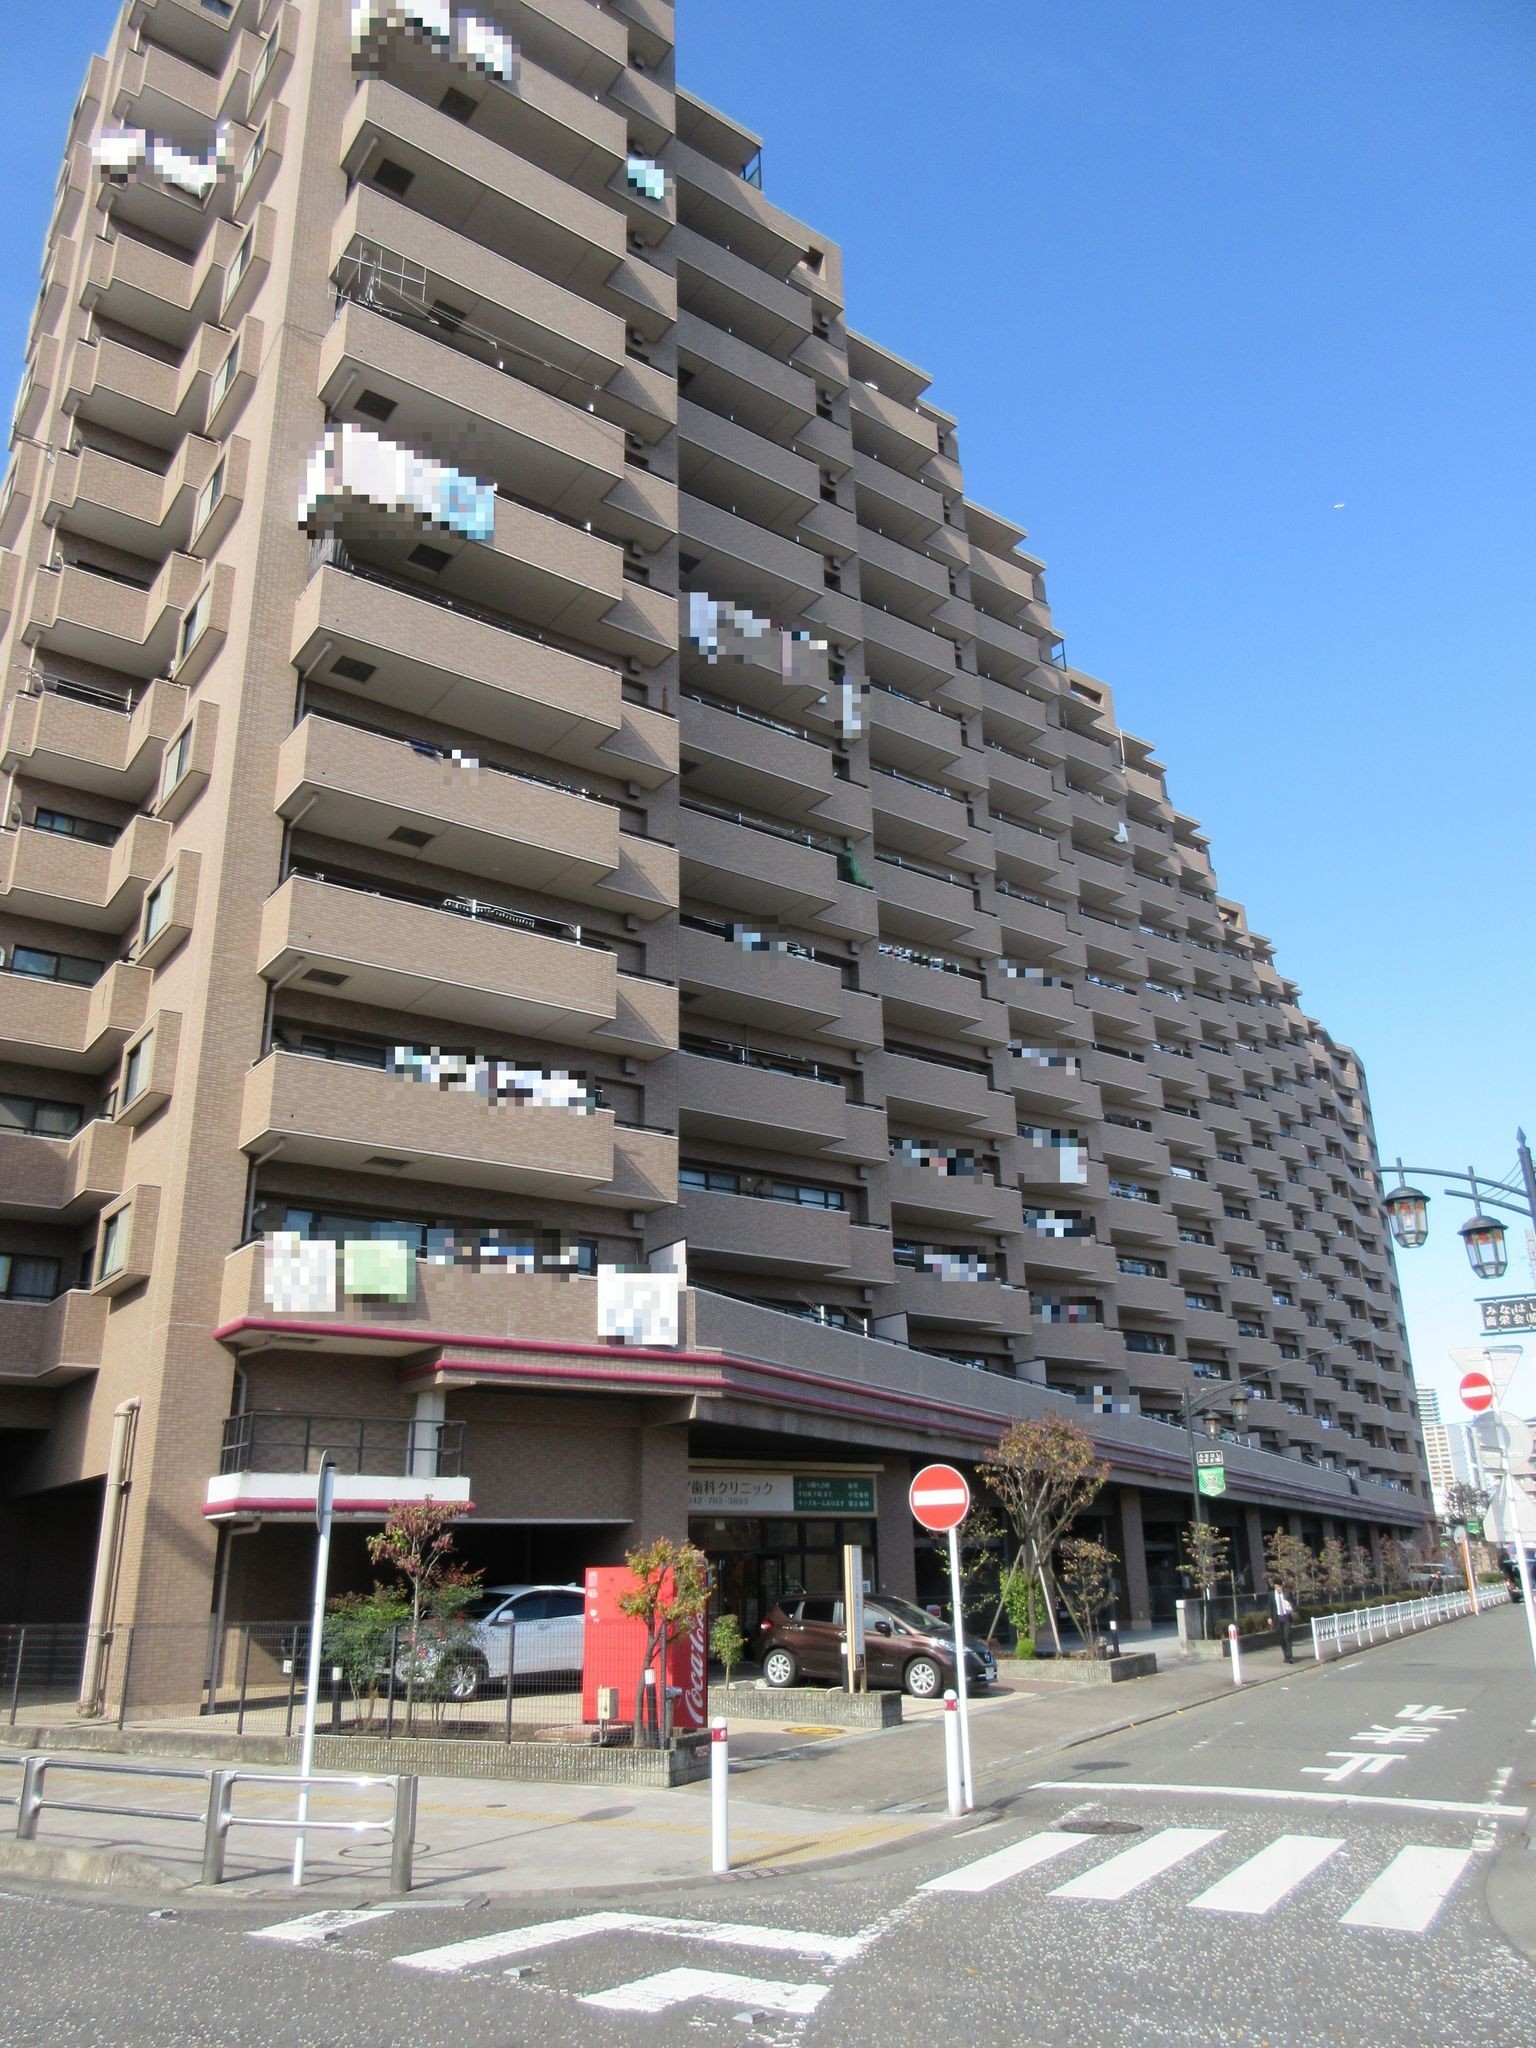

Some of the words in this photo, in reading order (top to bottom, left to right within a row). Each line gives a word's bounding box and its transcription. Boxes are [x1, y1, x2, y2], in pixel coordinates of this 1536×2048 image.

[688, 1480, 773, 1496] 歯科クリニック
